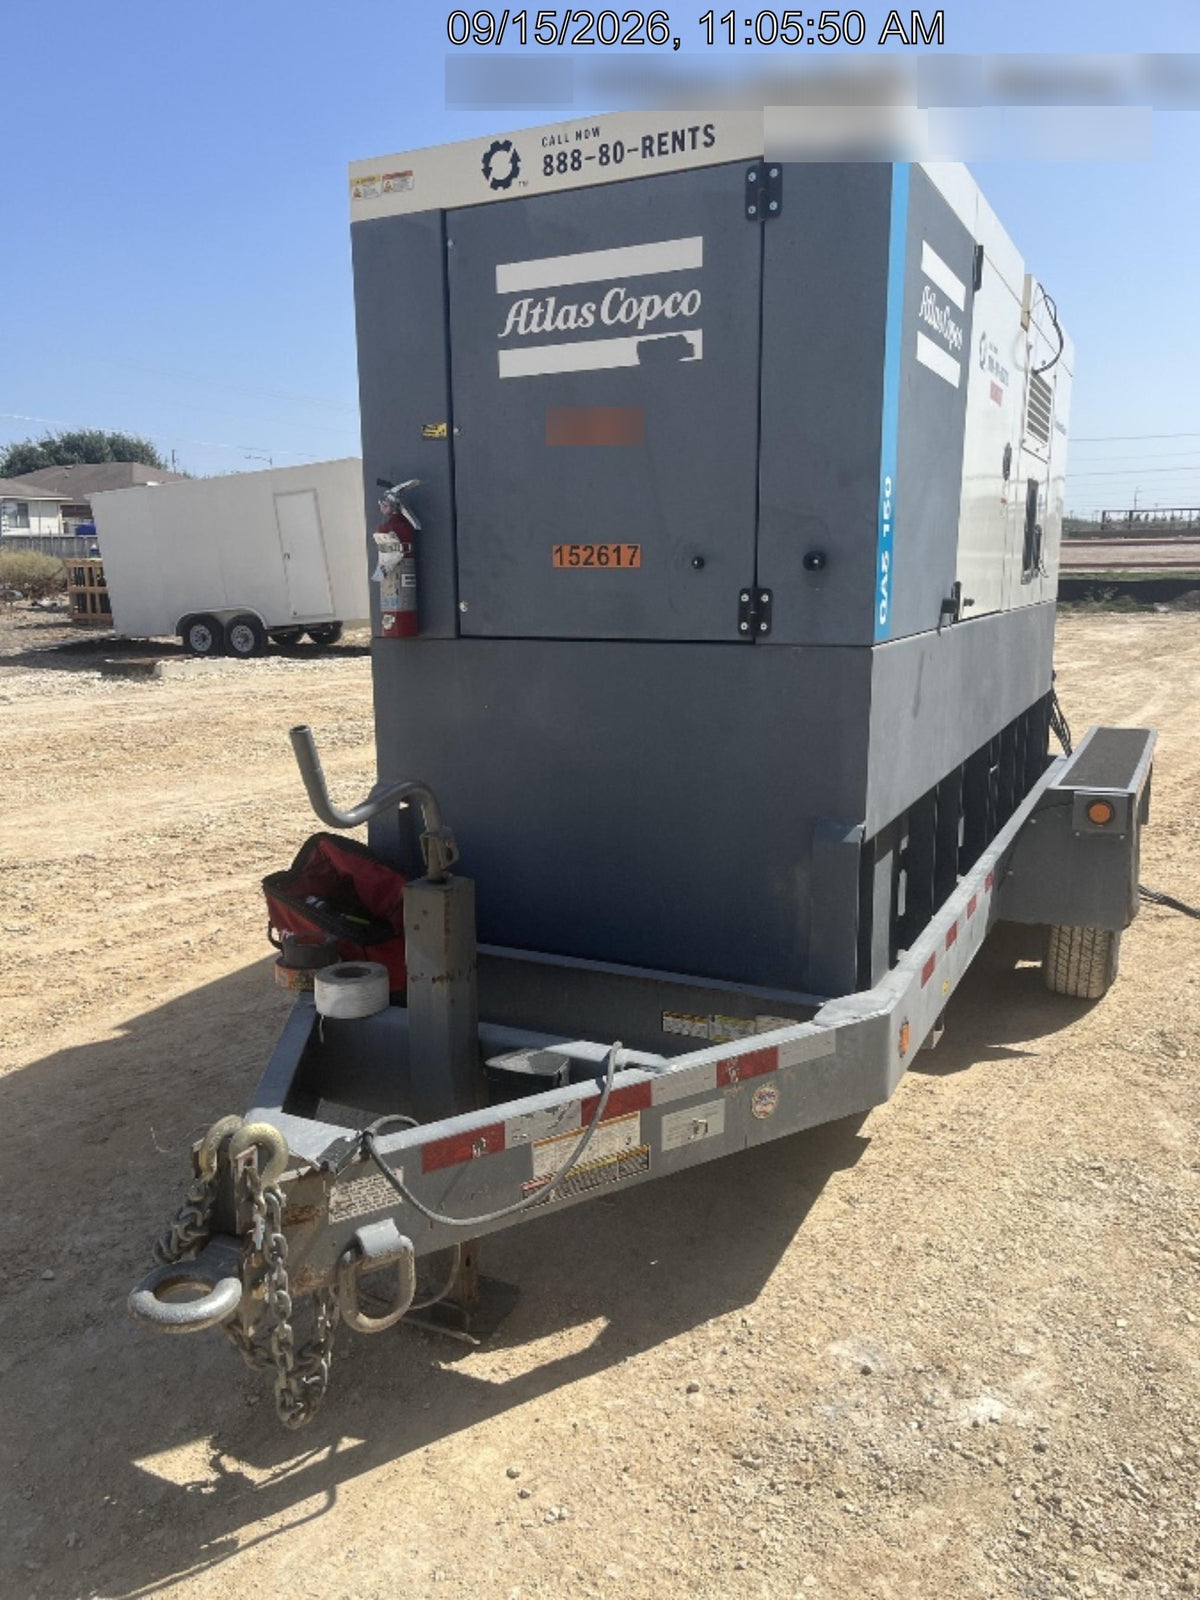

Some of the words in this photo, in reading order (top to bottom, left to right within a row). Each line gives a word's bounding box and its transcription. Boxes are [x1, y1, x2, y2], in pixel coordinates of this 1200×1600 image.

[541, 131, 570, 148] CALL
[575, 126, 601, 142] NOW
[542, 123, 716, 177] 888-80-RENTS
[497, 296, 597, 338] Atlas
[600, 287, 702, 330] Copco
[918, 285, 944, 333] Atlas
[554, 544, 639, 567] 152617
[879, 550, 890, 625] QAS
